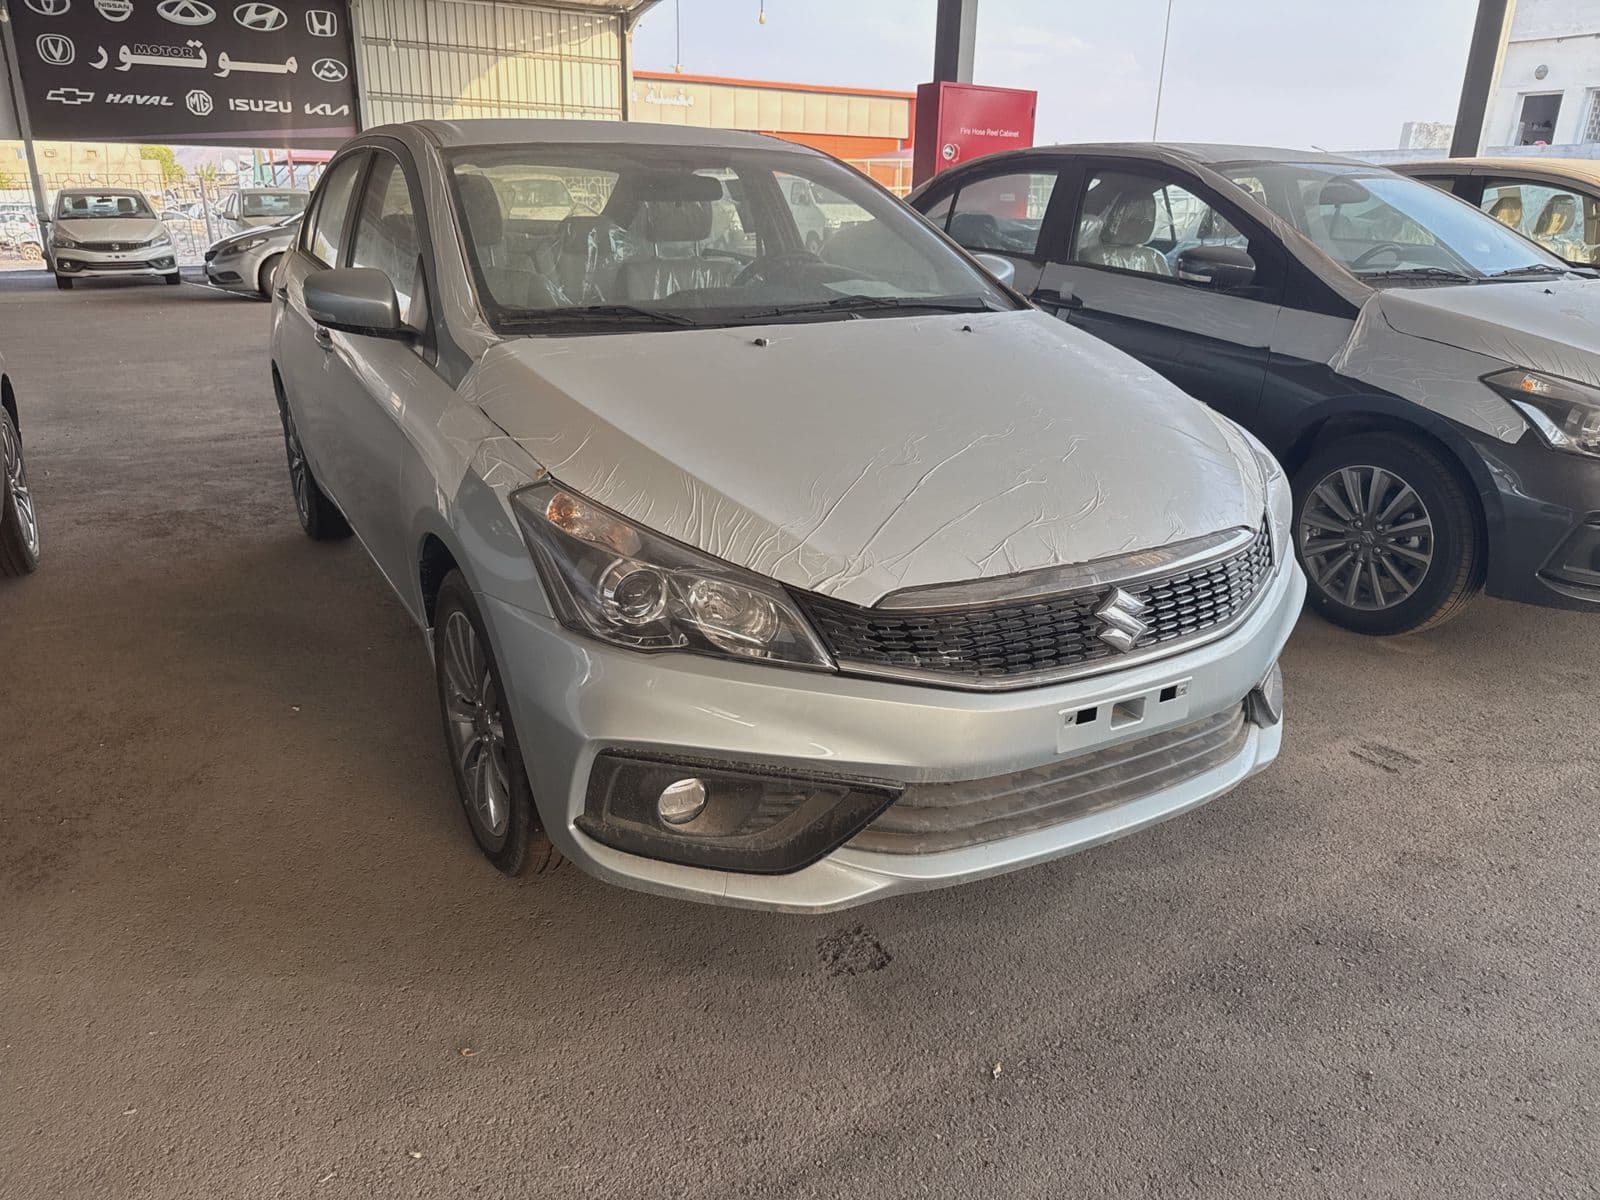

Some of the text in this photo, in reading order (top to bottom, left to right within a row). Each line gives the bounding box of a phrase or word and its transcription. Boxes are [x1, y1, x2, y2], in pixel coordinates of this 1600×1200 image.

[134, 44, 194, 58] MOTOR
[105, 93, 174, 106] HAVAL
[187, 91, 212, 114] MG
[228, 98, 293, 113] ISUZU
[960, 127, 1020, 138] Fire Hose Reel Cabinet
